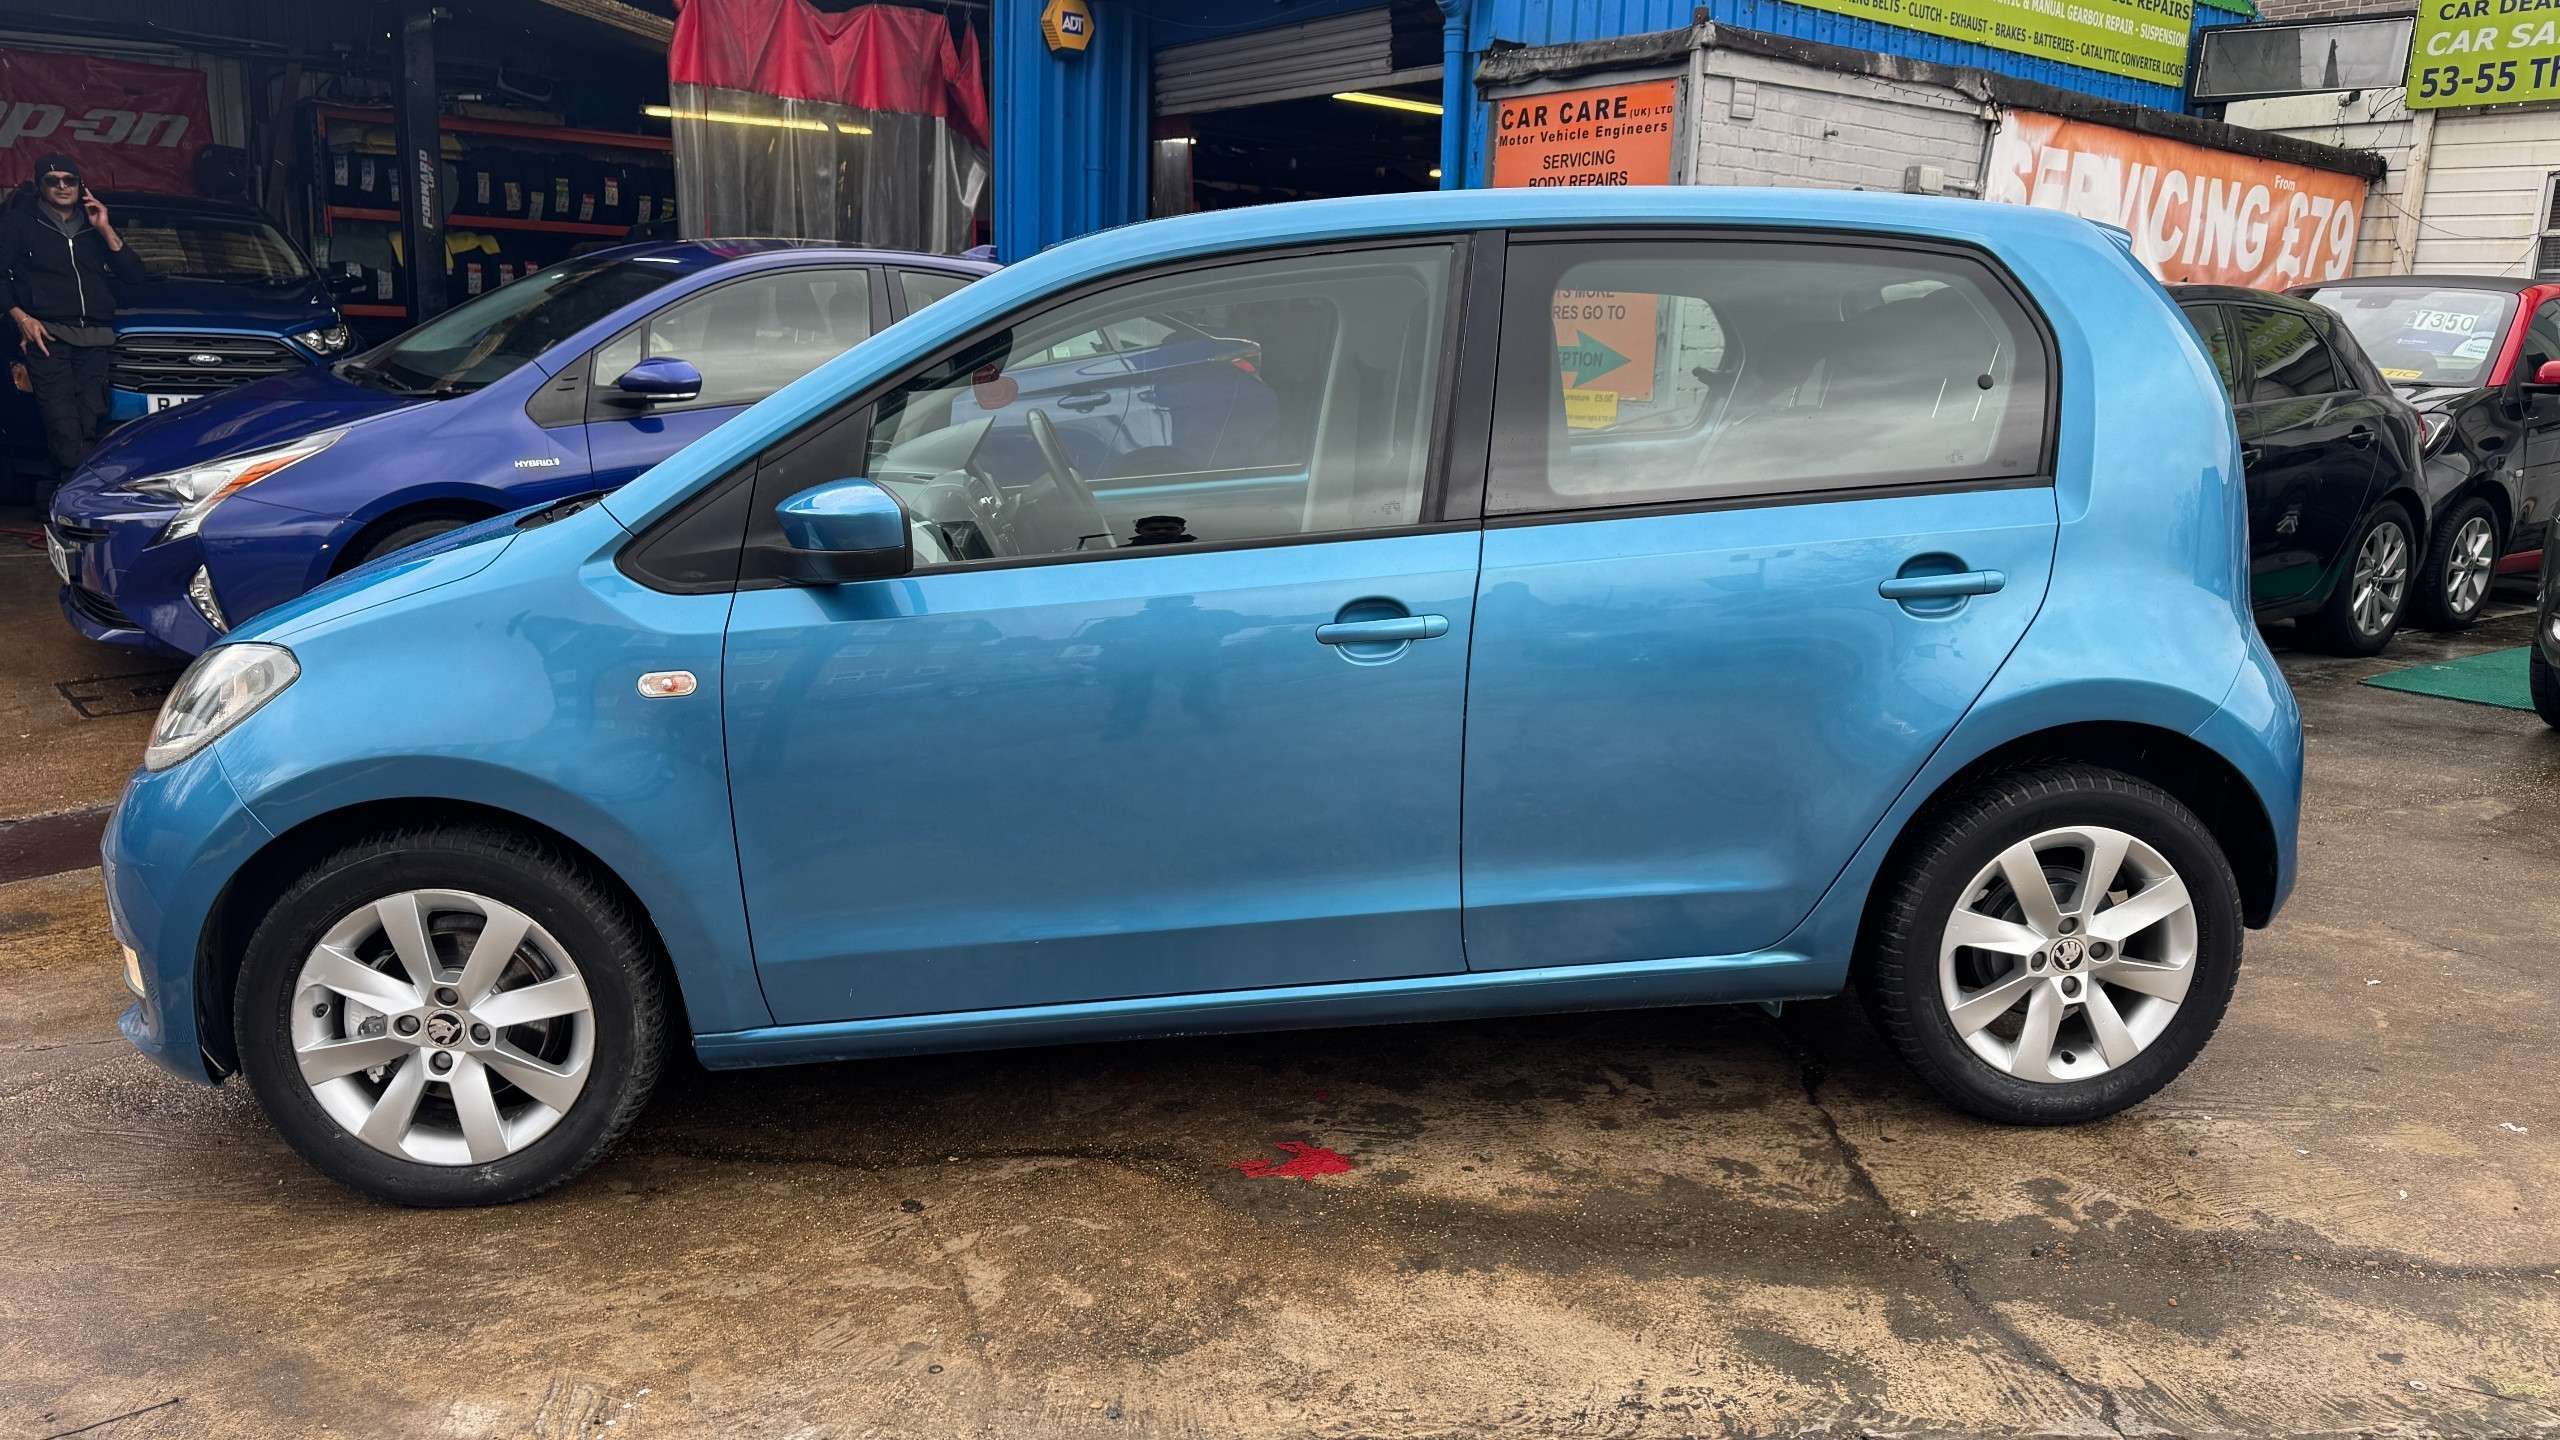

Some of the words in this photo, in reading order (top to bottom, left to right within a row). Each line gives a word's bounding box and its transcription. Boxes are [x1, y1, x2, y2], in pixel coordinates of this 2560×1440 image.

[1062, 15, 1083, 32] ADT
[2032, 0, 2066, 18] MANUAL
[2067, 5, 2104, 28] GEARBOX
[2105, 14, 2134, 35] REPAIR
[2140, 23, 2187, 48] SUSPENSION
[2137, 0, 2190, 20] REPAIRS
[2440, 0, 2490, 20] CAR
[1872, 0, 1900, 13] BELTS
[1908, 5, 1942, 22] CLUTCH
[1950, 12, 1988, 34] EXHAUST
[1995, 23, 2027, 42] BRAKES
[2033, 31, 2075, 53] BATTERIES
[2080, 42, 2120, 63] CATALYTIC
[2121, 52, 2161, 73] CONVERTER
[2162, 62, 2184, 78] LOCKS
[2427, 28, 2498, 56] CAR
[2507, 21, 2560, 49] SA
[2420, 60, 2517, 98] 53-55
[0, 101, 190, 148] p-on
[1501, 105, 1547, 130] CAR
[1559, 96, 1628, 124] CARE
[1630, 108, 1650, 120] (UK)
[1655, 104, 1673, 114] LTD
[1500, 133, 1535, 147] Motor
[1541, 128, 1589, 143] Vehicle
[1595, 121, 1668, 139] Engineers
[1543, 149, 1616, 170] SERVICING
[419, 149, 433, 229] FORWARD
[1529, 175, 1566, 187] BODY
[1569, 170, 1628, 187] REPAIRS
[2274, 175, 2296, 190] From
[1986, 136, 2270, 273] SERVICING
[2276, 191, 2354, 281] £79
[1583, 305, 1603, 320] GO
[1608, 305, 1626, 320] TO
[514, 459, 554, 468] HYBRID
